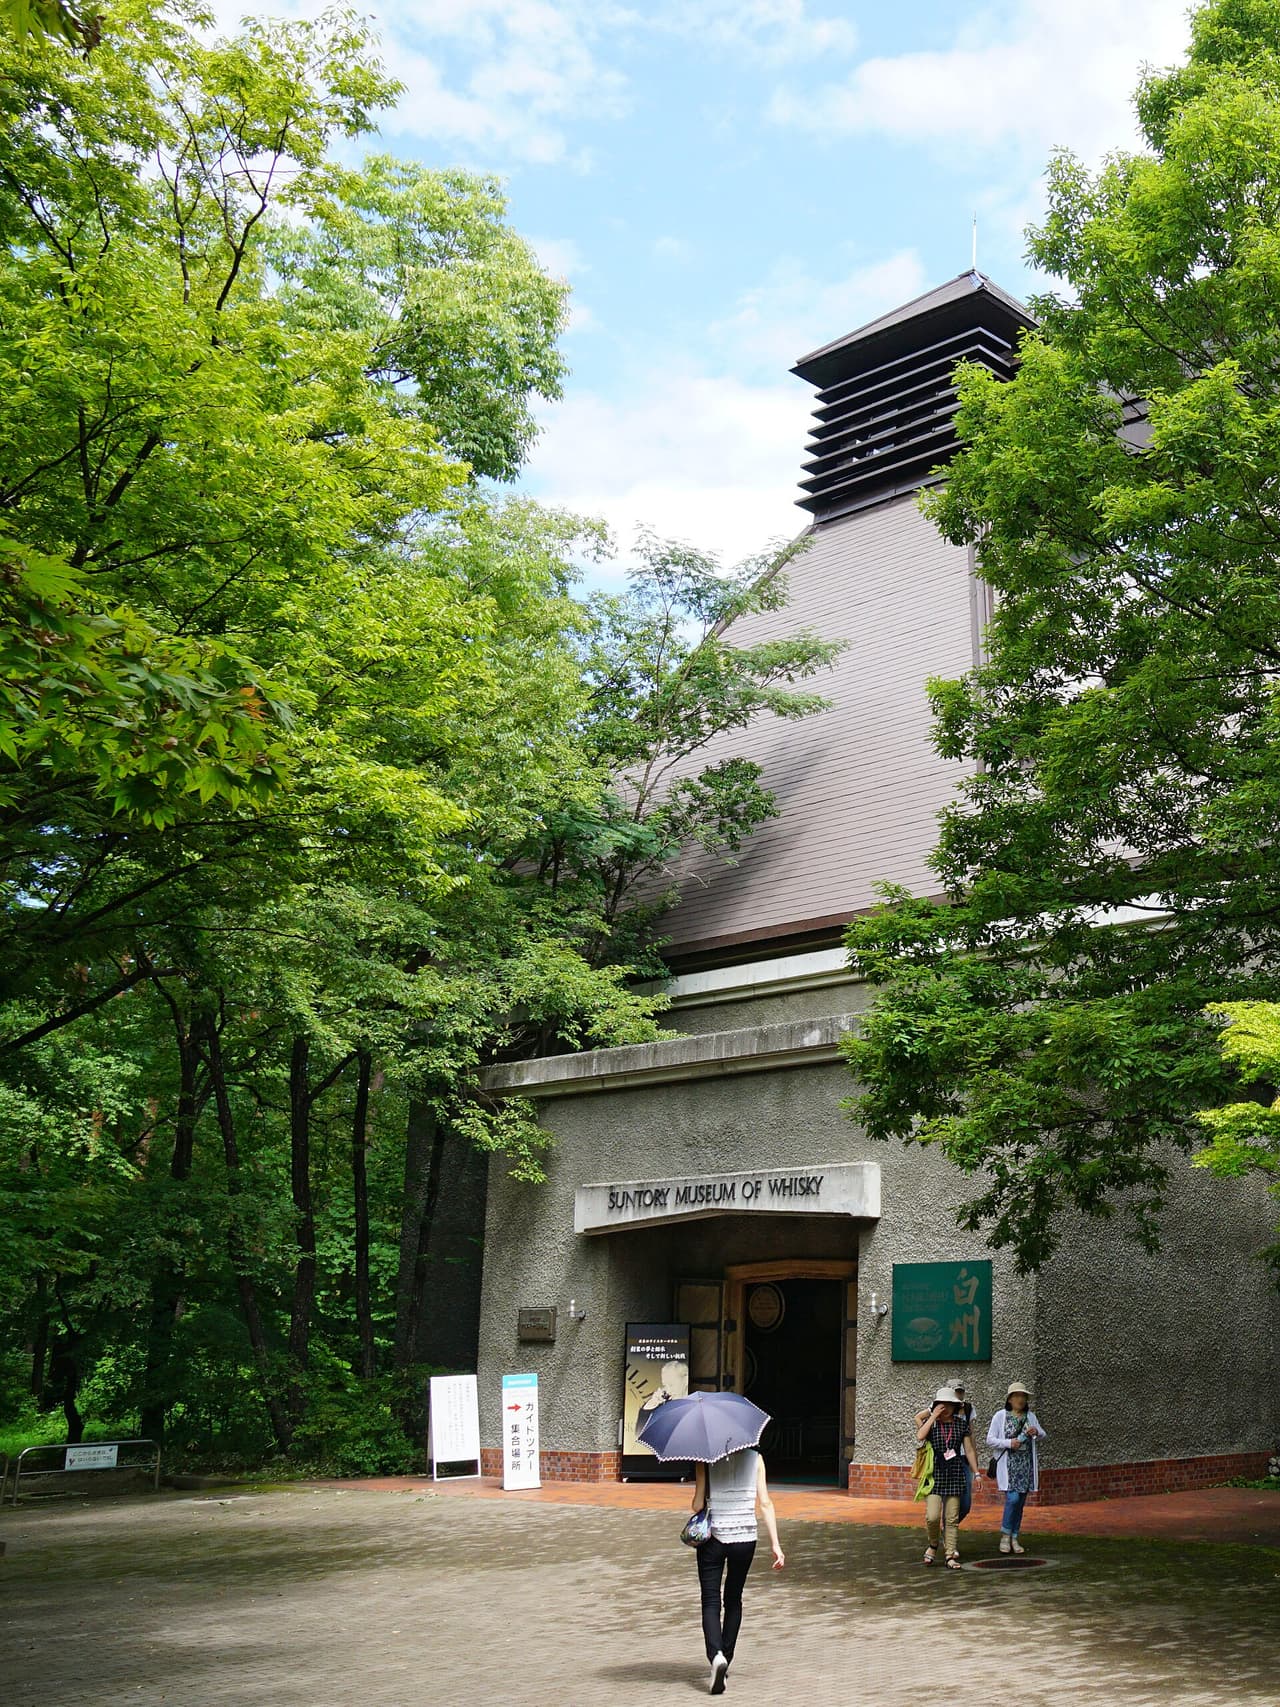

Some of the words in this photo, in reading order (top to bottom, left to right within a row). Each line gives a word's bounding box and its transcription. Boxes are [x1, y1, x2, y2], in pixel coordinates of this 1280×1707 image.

[608, 1187, 670, 1209] SUNTORY
[675, 1181, 736, 1204] MUSEUM
[741, 1179, 762, 1199] OF
[768, 1175, 824, 1196] WHISKY
[511, 1424, 520, 1471] 集合場所
[525, 1401, 535, 1471] ガイドツアー
